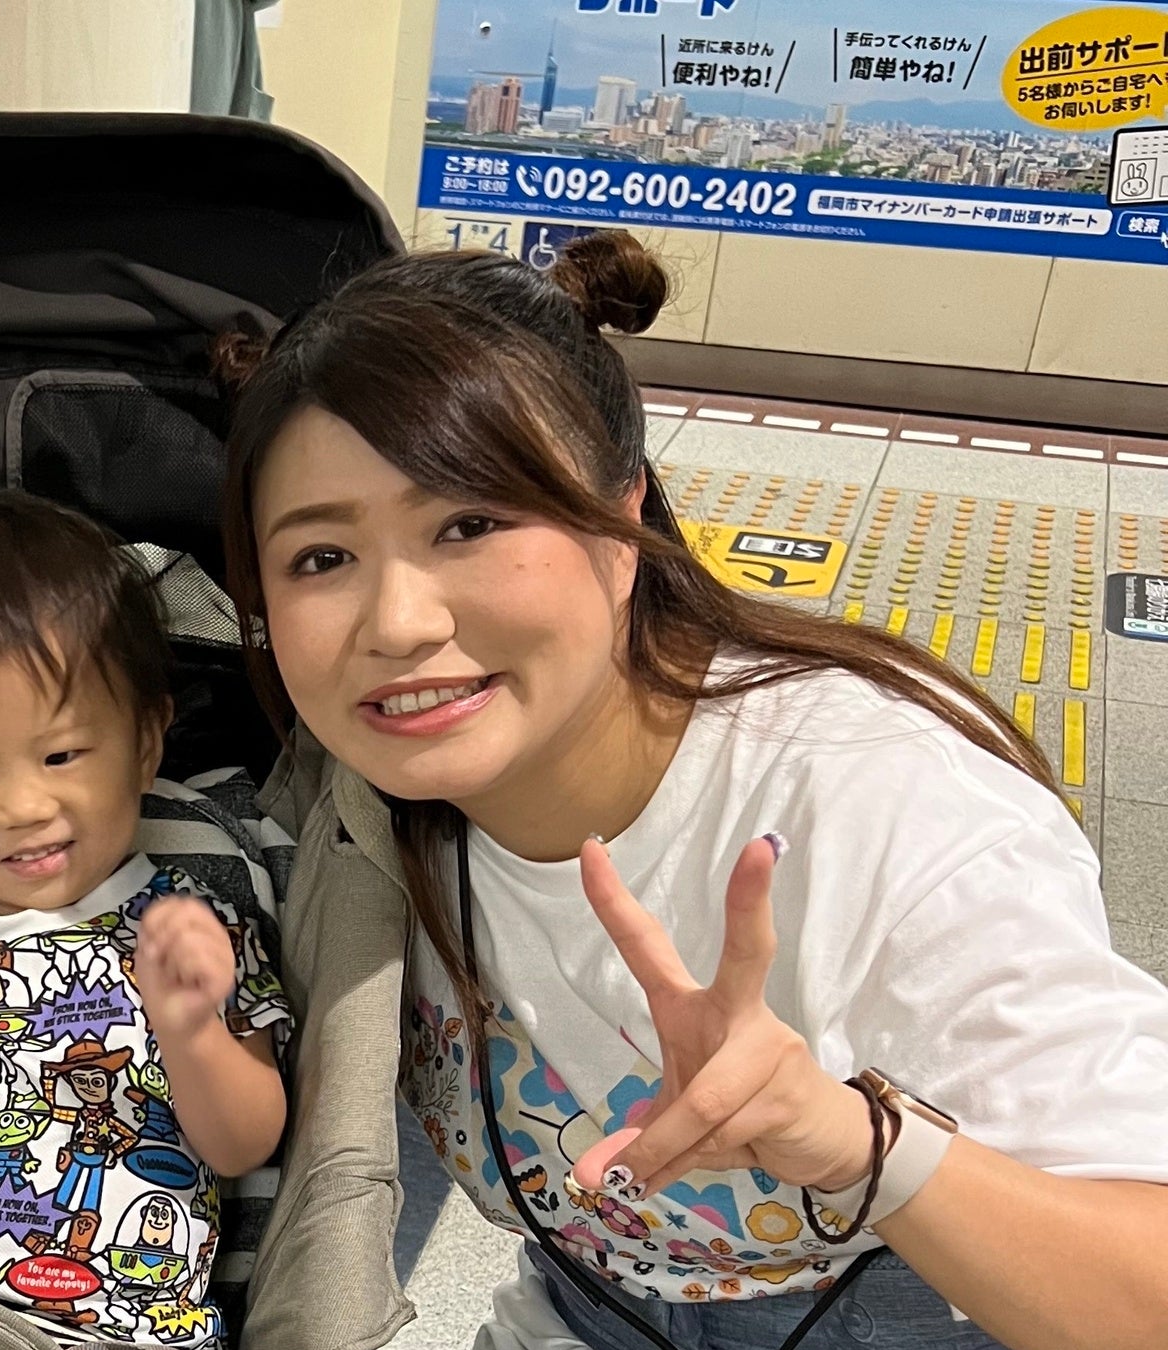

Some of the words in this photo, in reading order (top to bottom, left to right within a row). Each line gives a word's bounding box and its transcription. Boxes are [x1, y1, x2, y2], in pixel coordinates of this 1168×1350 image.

[678, 38, 774, 56] 近所に来るけん
[844, 32, 972, 52] 手伝ってくれるけん
[1018, 73, 1168, 102] 5名様からご自宅へ
[445, 155, 510, 176] ご予約は
[543, 166, 797, 216] 092-600-2402
[817, 195, 1098, 228] 福岡市マイナンバーカード申請出張サポート
[1128, 216, 1161, 234] 検索
